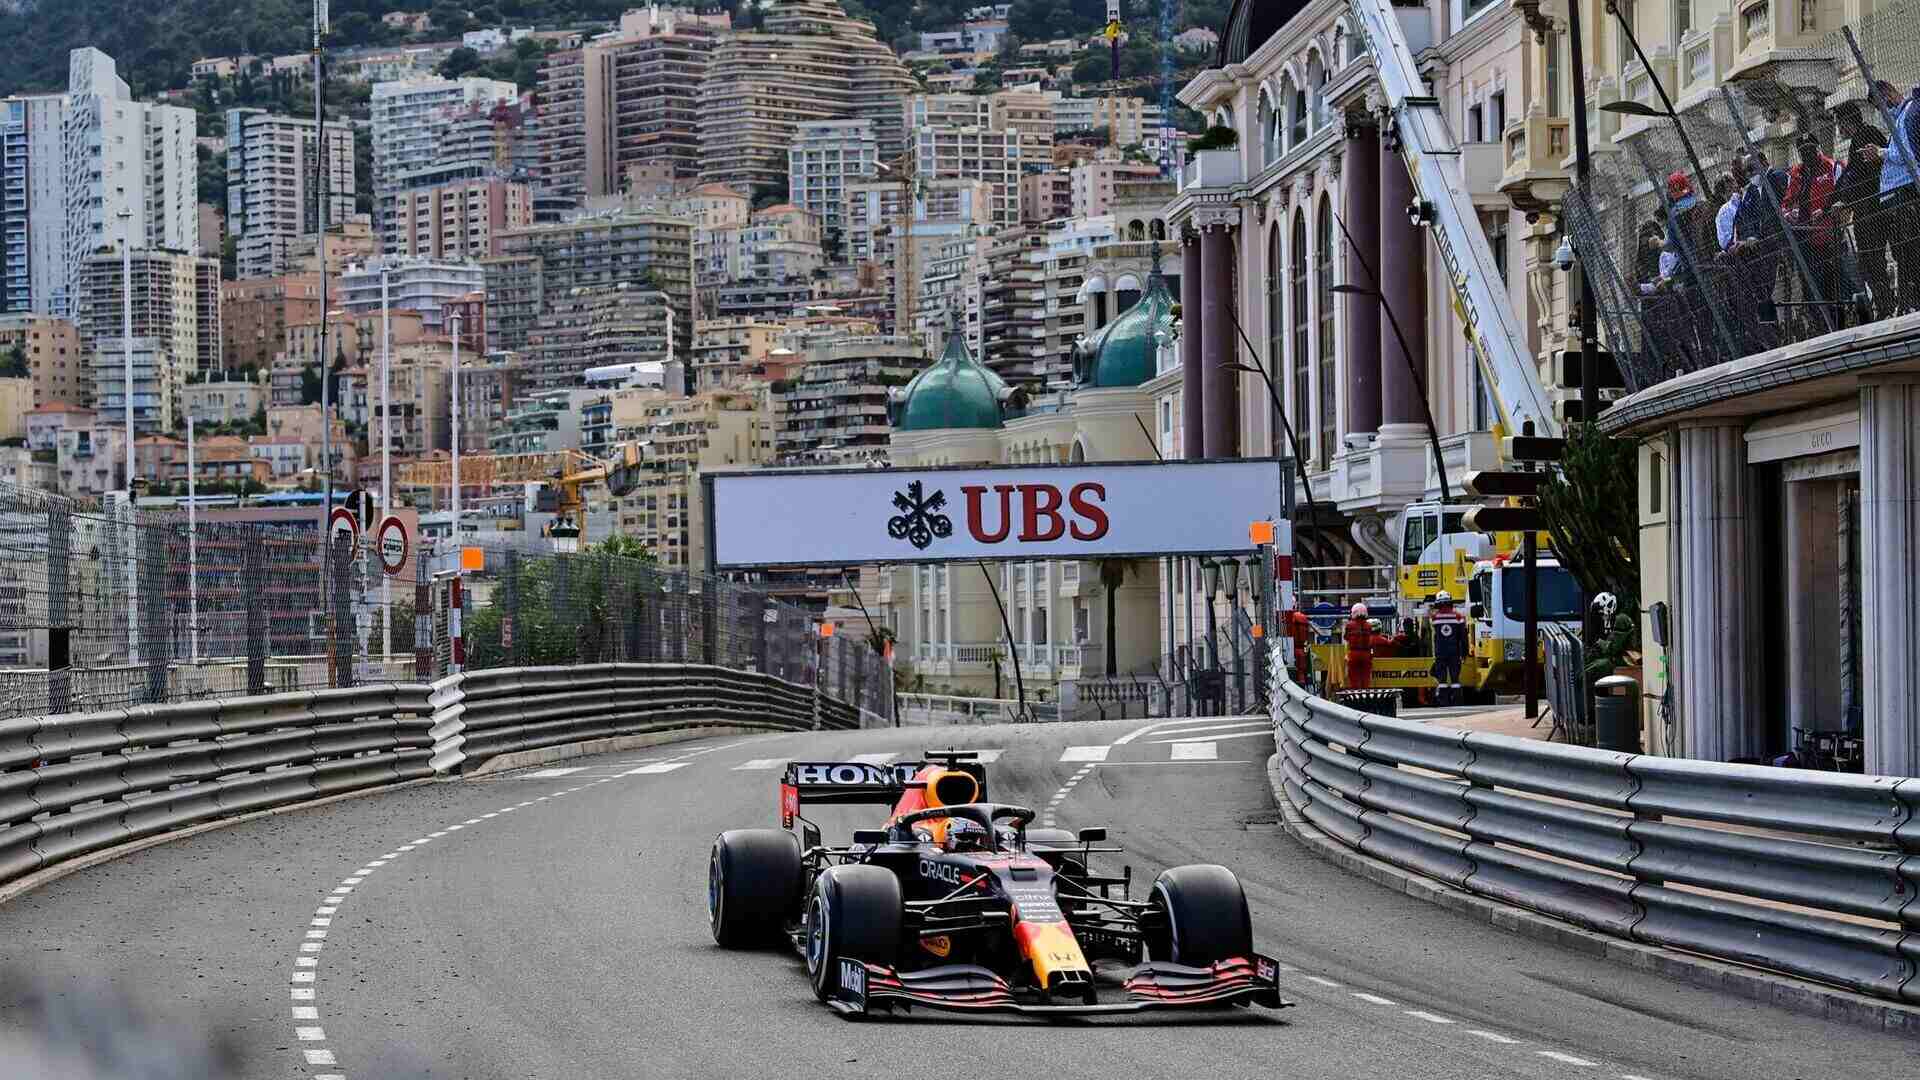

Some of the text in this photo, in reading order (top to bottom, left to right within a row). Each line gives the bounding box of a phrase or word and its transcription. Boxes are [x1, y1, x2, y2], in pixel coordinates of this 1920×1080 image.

[960, 482, 1109, 543] UBS
[1371, 669, 1429, 679] MEDIACO
[920, 860, 960, 885] ORACLE
